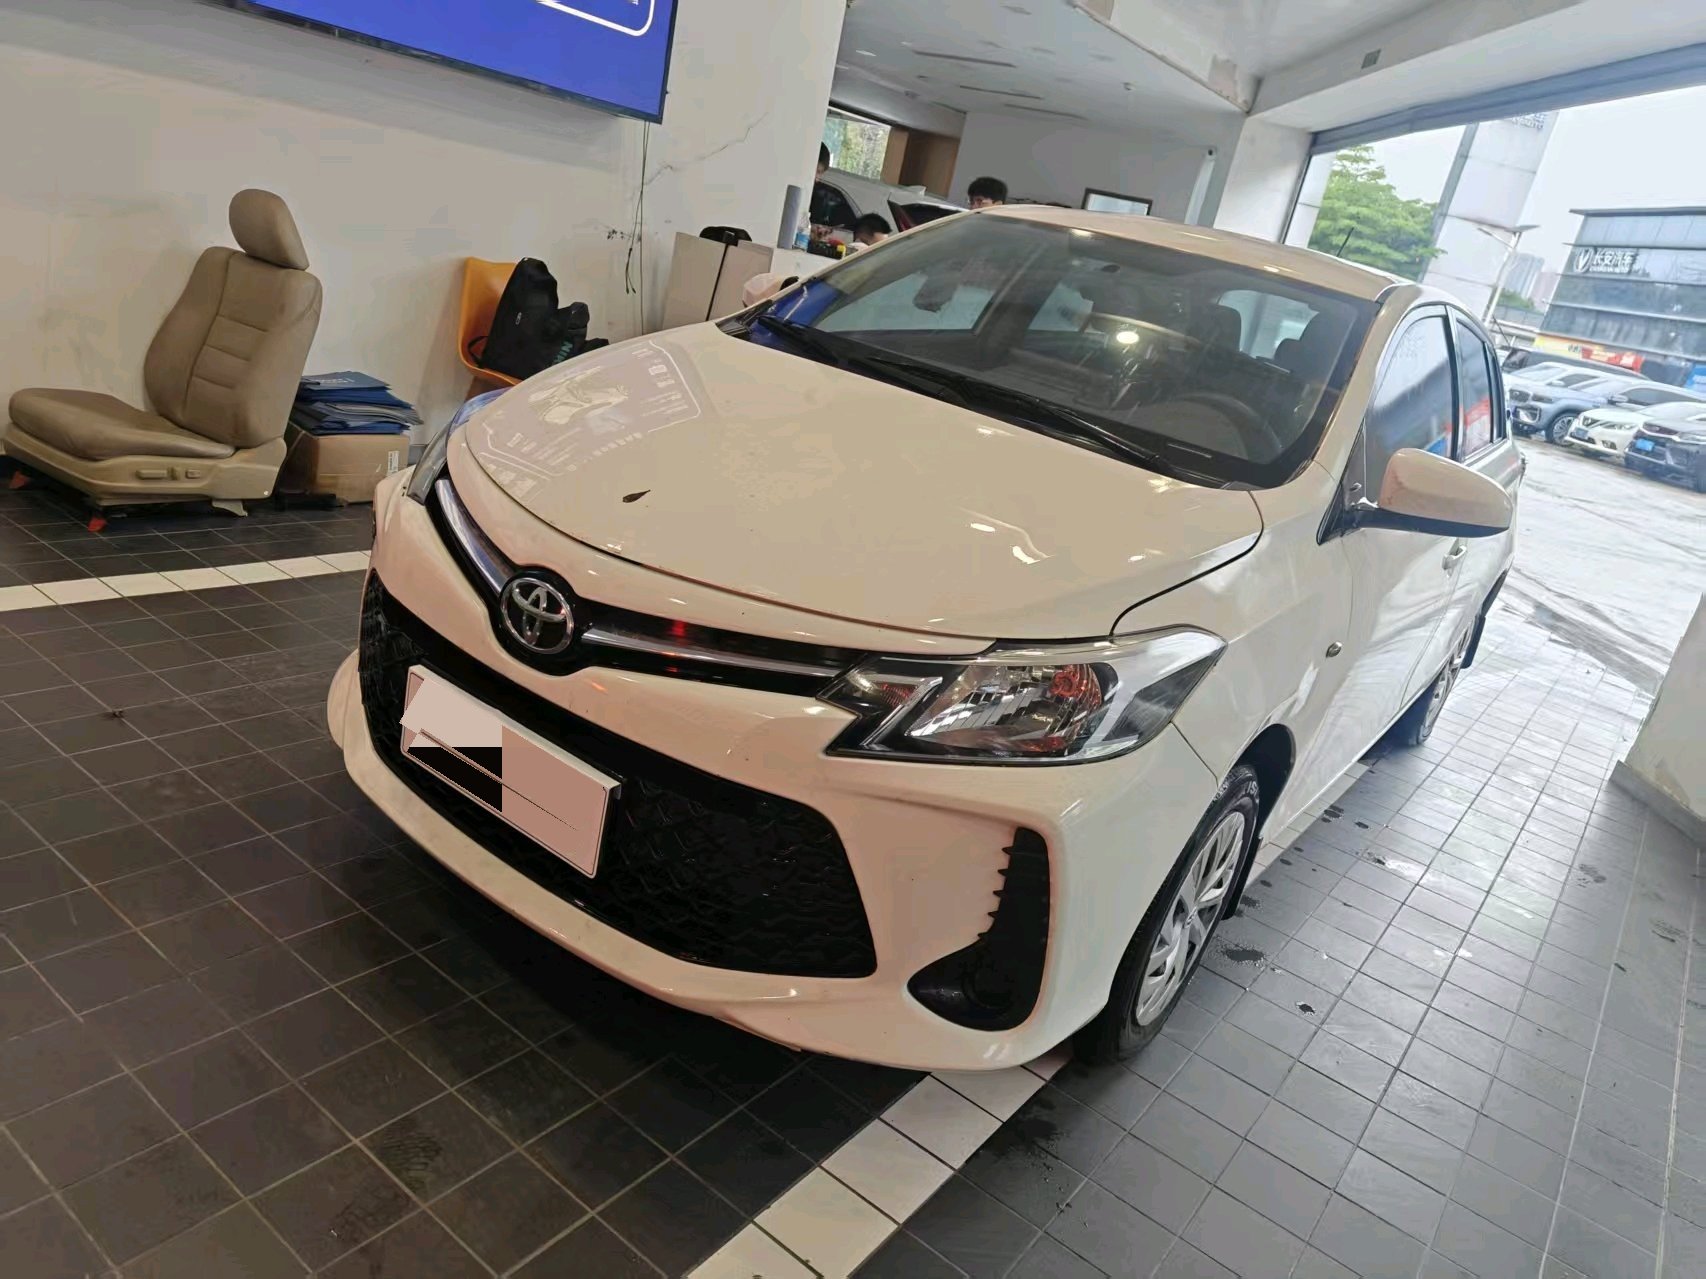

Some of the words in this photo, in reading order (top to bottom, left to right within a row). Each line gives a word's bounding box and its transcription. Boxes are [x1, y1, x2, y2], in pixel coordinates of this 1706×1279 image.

[1593, 249, 1634, 267] 长安汽车
[553, 341, 573, 363] NIK
